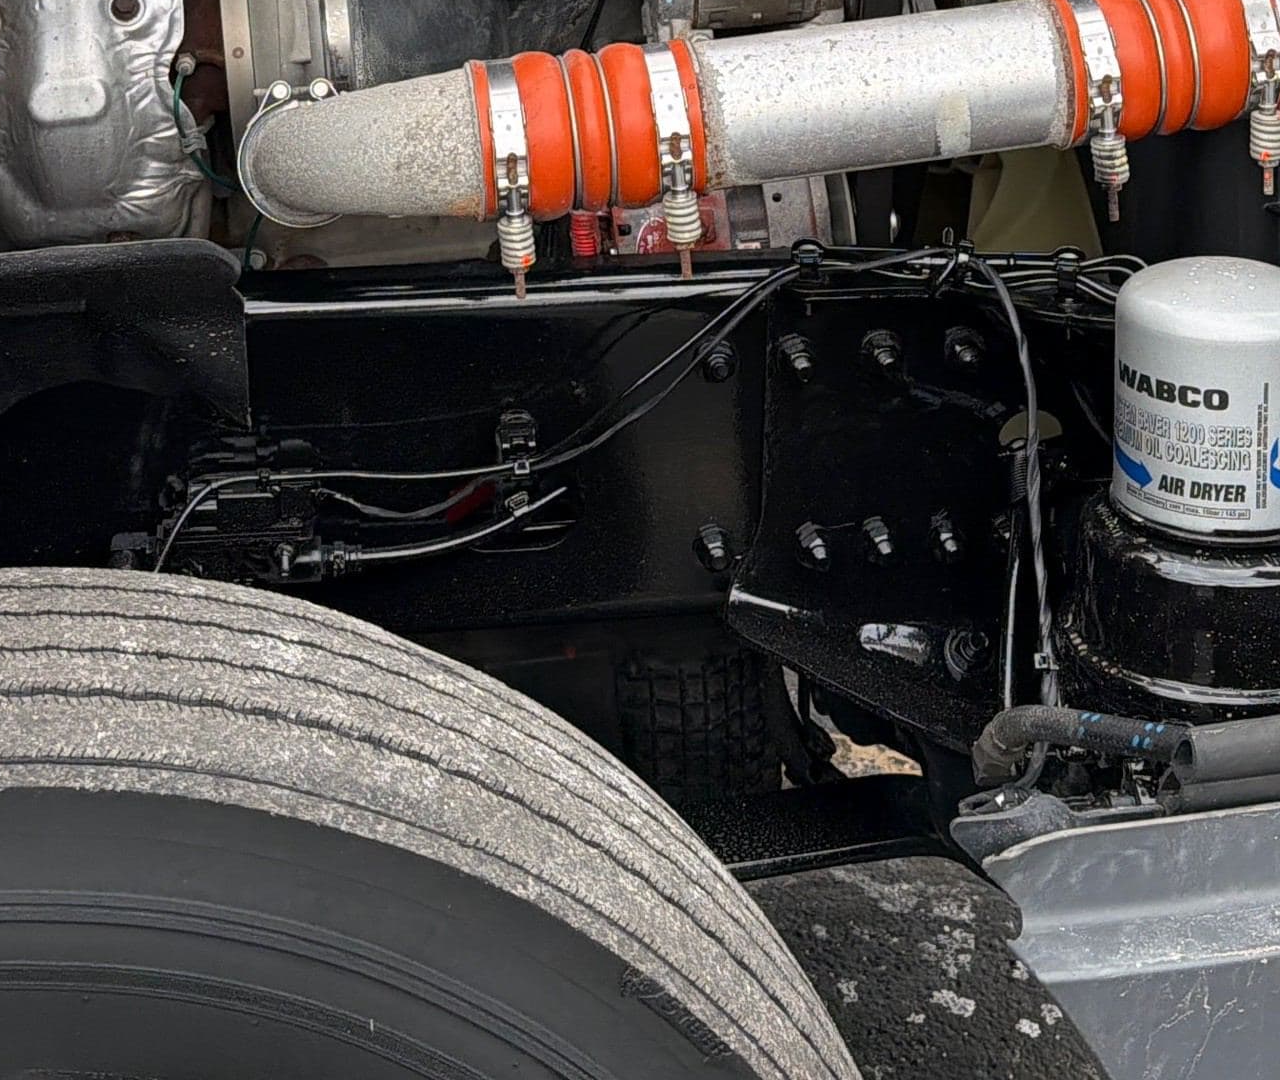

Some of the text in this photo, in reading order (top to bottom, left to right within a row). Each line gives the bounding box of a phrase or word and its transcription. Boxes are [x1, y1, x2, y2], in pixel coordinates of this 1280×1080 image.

[1119, 359, 1229, 411] WABCO
[1138, 407, 1170, 440] SAVER
[1174, 419, 1206, 446] 1200
[1208, 425, 1253, 449] SERIES
[1144, 434, 1163, 461] OIL
[1164, 440, 1252, 471] COALESCING
[1158, 473, 1247, 503] AIR DRYER
